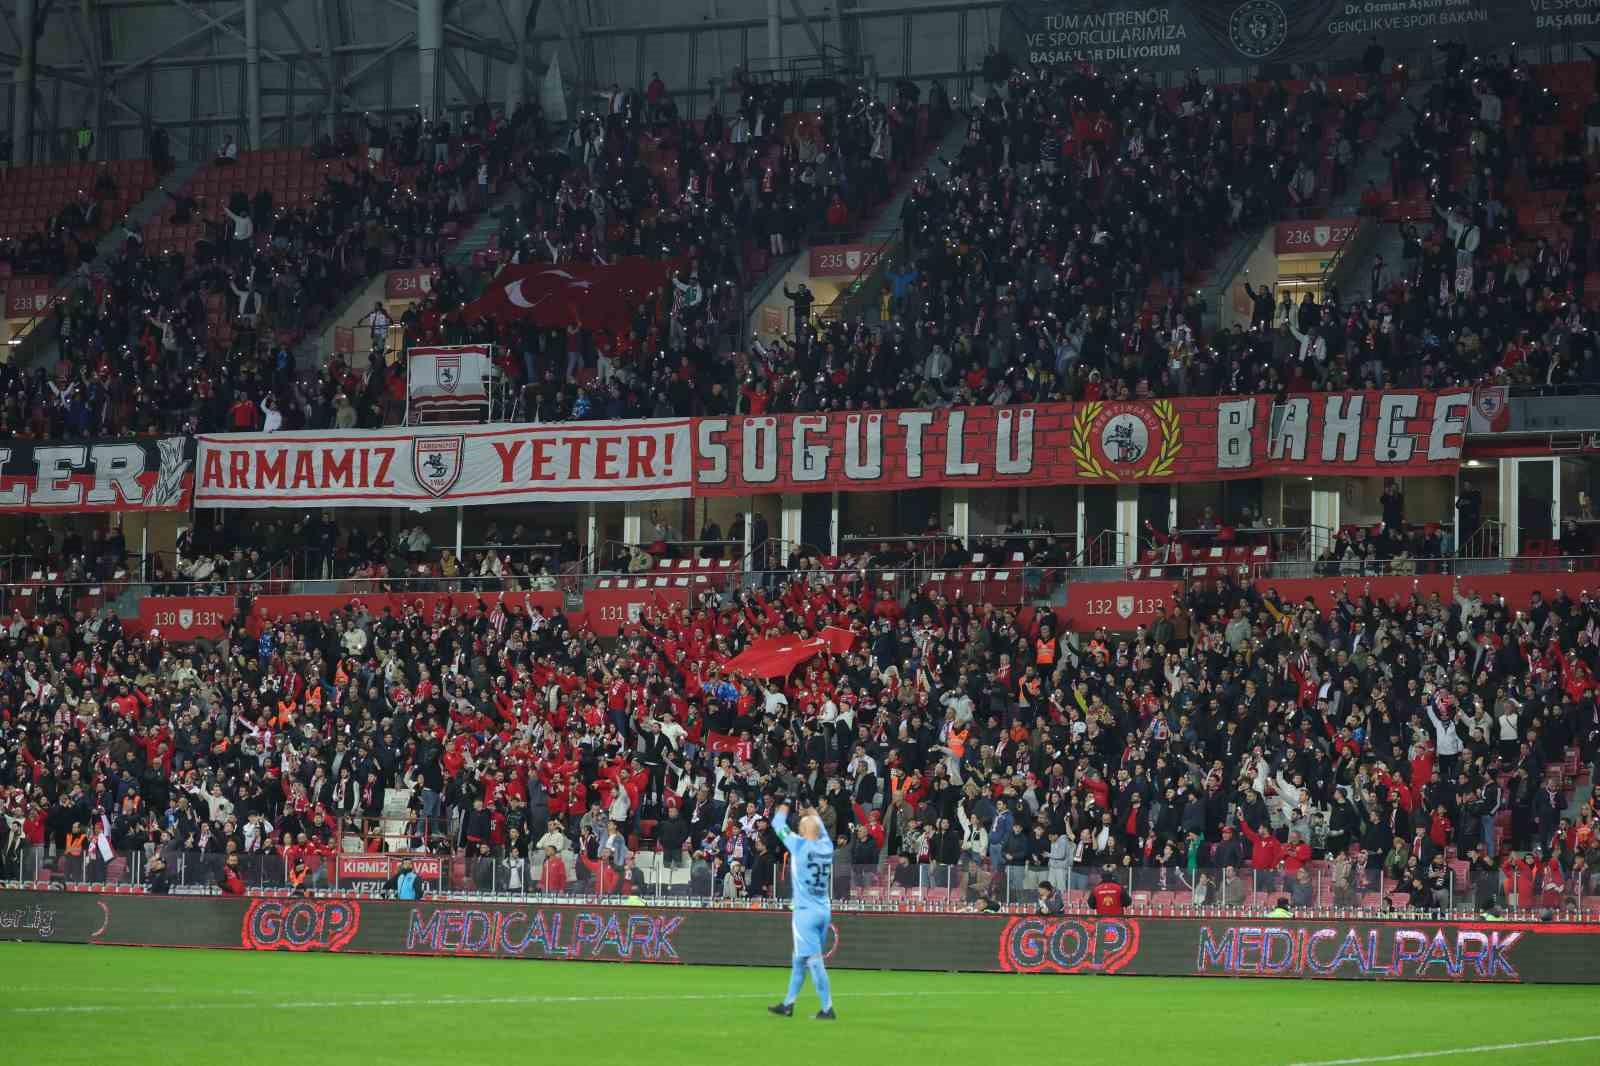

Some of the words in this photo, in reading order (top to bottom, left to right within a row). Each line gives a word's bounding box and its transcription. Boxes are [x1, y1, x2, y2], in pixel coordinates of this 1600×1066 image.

[1084, 8, 1168, 28] ANTRENÖR
[1404, 14, 1437, 28] SPOR
[1025, 33, 1045, 47] VE
[1287, 230, 1311, 244] 236
[820, 254, 842, 268] 235
[395, 277, 416, 290] 234
[14, 296, 32, 310] 233
[201, 446, 396, 490] ARMAMIZ
[492, 433, 675, 483] YETER!
[600, 606, 624, 620] 131
[1087, 599, 1112, 615] 132
[155, 611, 176, 625] 130
[195, 611, 217, 625] 131
[253, 901, 351, 945] GOP
[1012, 918, 1127, 967] GOP
